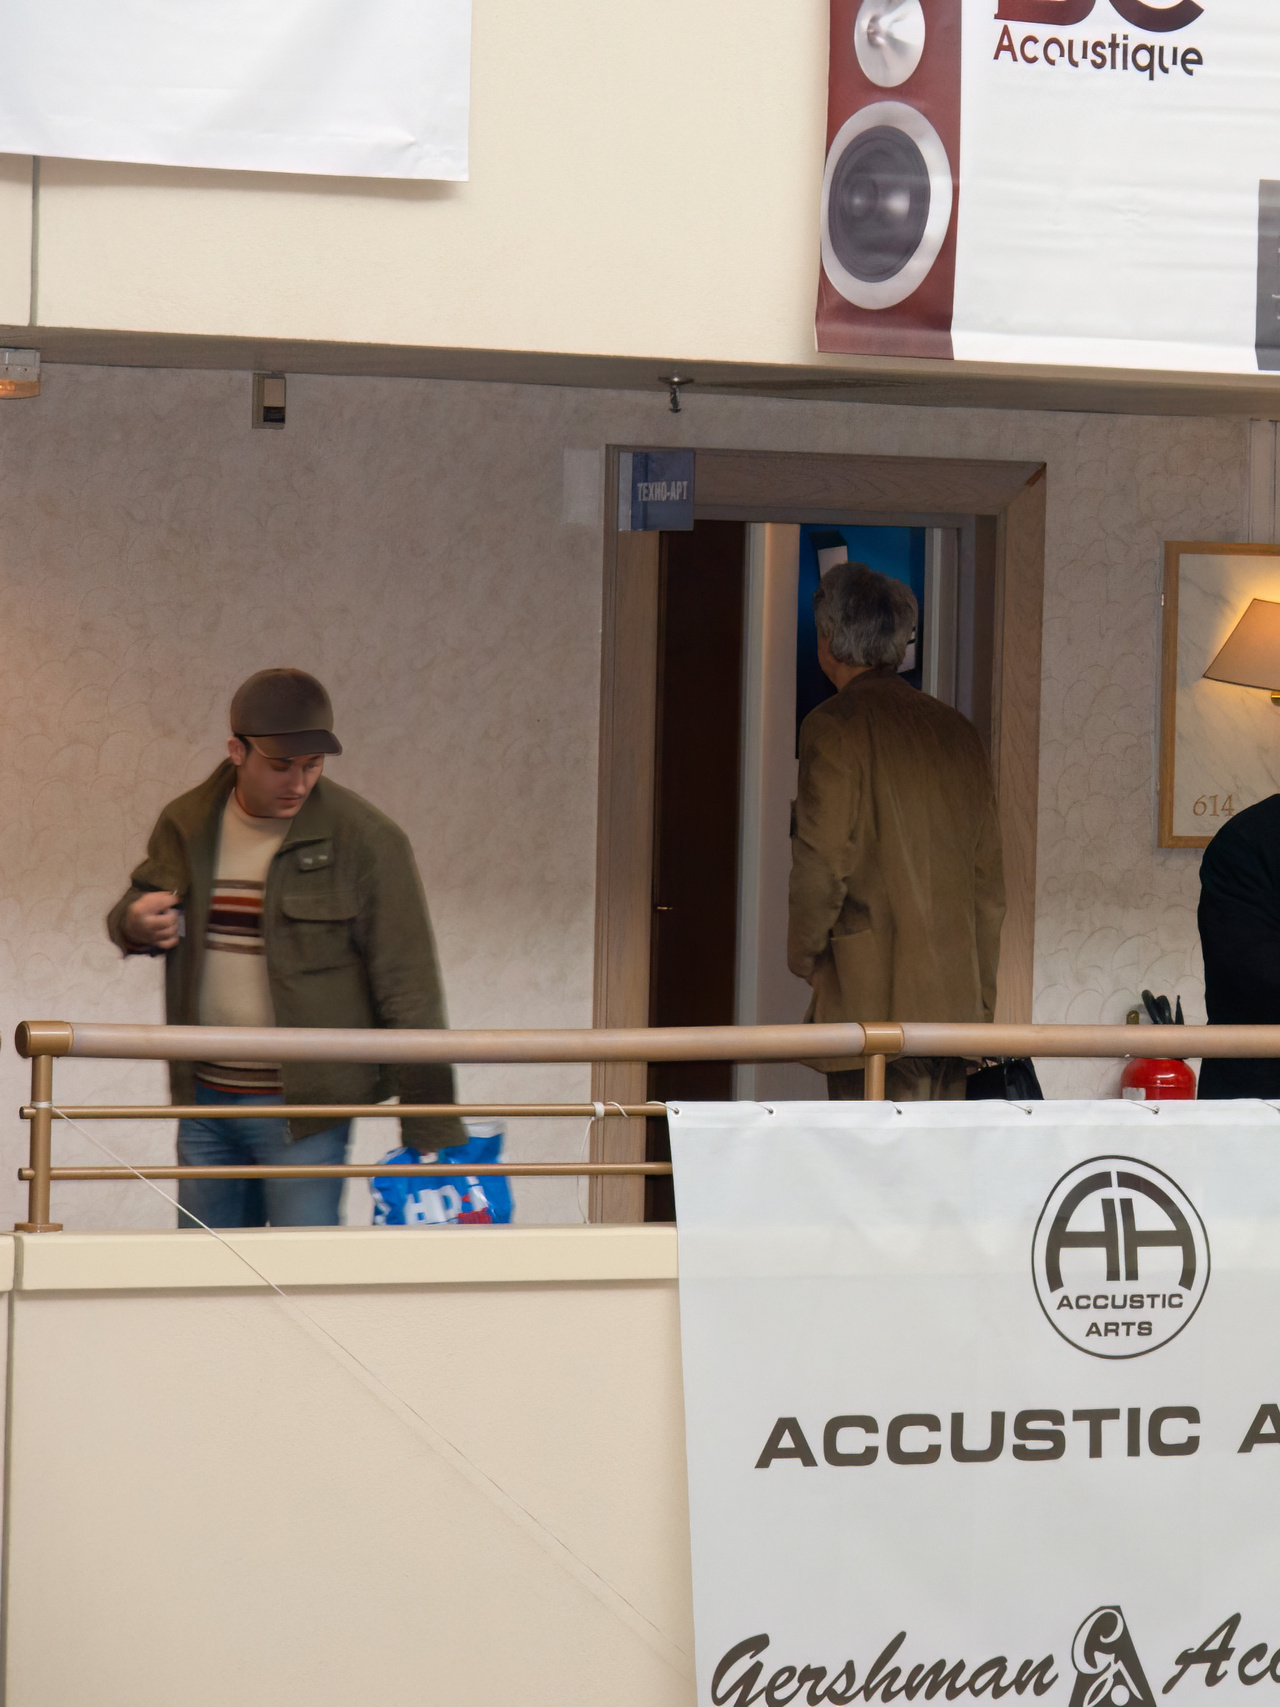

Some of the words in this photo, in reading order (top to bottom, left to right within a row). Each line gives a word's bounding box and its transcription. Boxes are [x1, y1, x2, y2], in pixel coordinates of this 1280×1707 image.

[993, 24, 1203, 81] Acoustique
[637, 481, 688, 502] ТЕХНО-АРТ
[1192, 794, 1235, 817] 614
[1056, 1293, 1184, 1310] ACCUSTIC
[1085, 1321, 1153, 1337] ARTS
[754, 1406, 1201, 1469] ACCUSTIC
[710, 1631, 1058, 1707] Gershman
